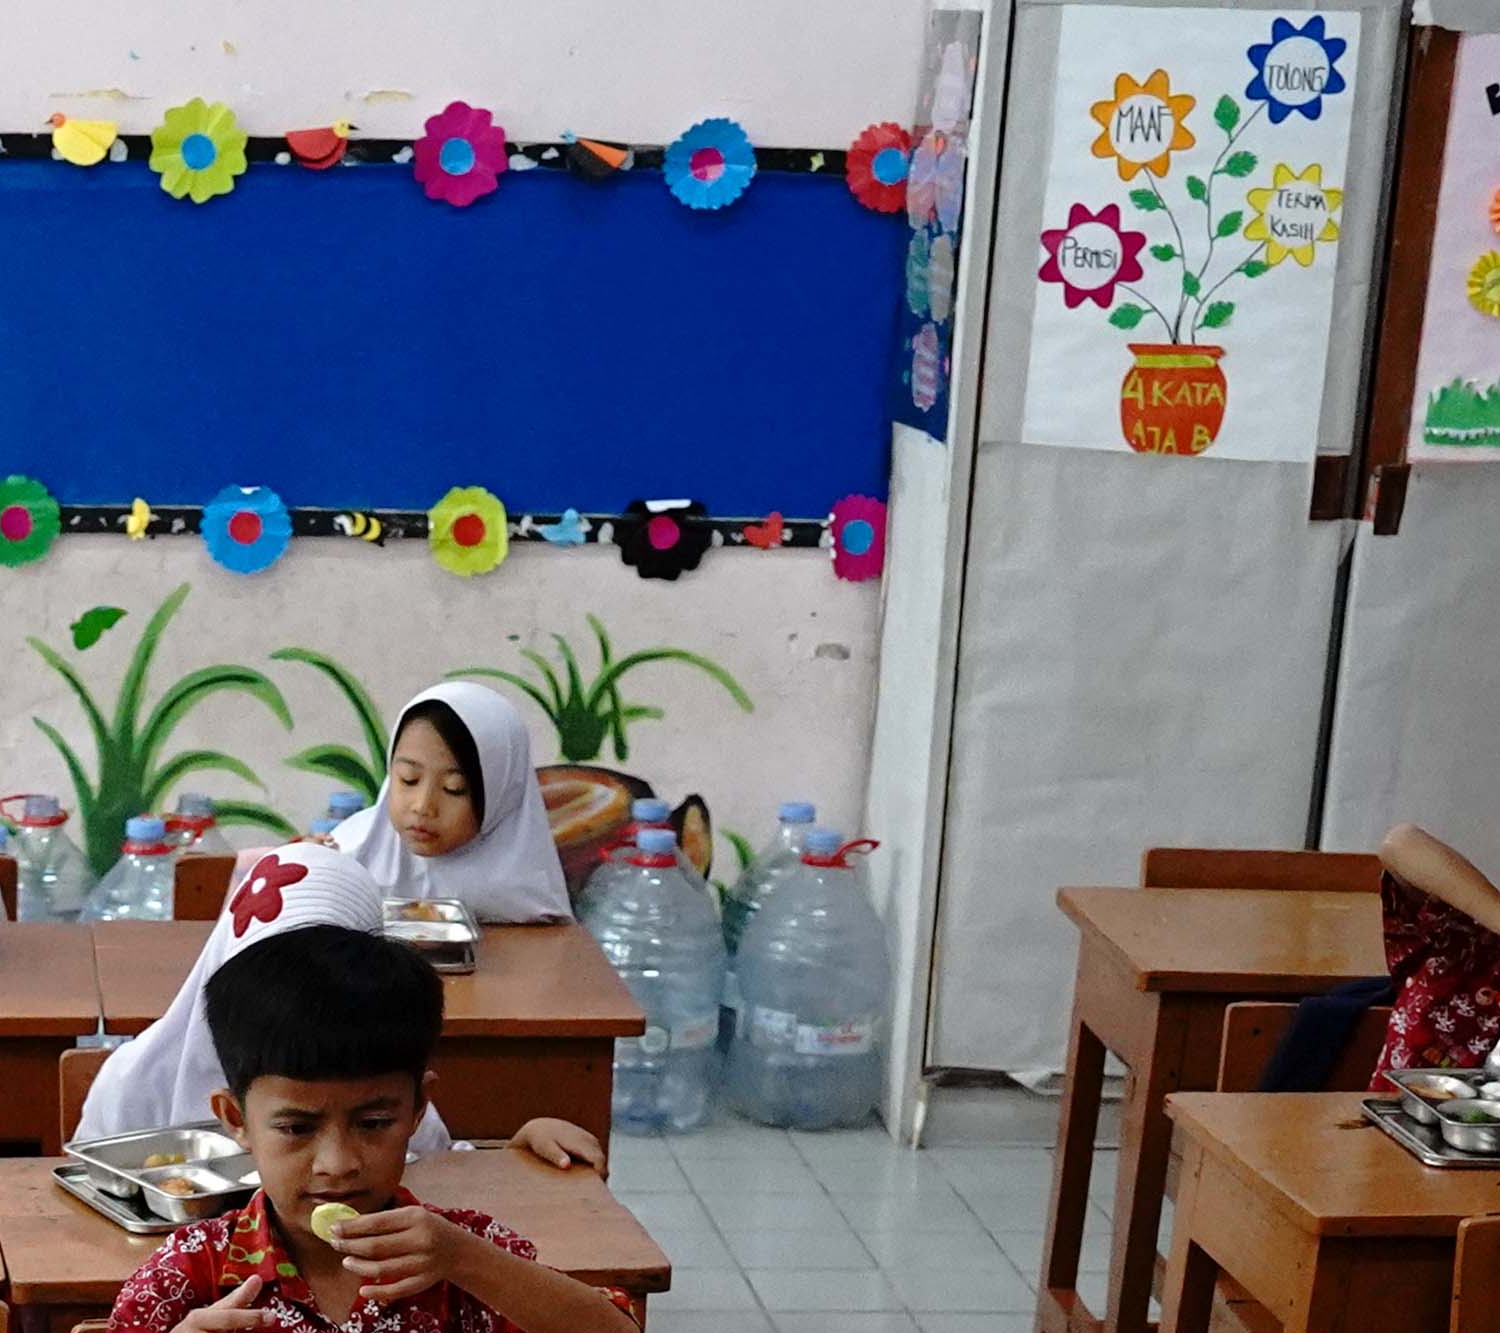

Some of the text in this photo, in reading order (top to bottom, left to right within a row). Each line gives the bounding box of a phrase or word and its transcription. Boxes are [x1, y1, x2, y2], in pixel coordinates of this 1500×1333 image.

[1268, 65, 1326, 93] TOLONG
[1116, 106, 1172, 143] MAAF
[1276, 188, 1326, 210] TERIMA
[1270, 217, 1316, 242] KASIH
[1122, 369, 1225, 410] 4 KATA
